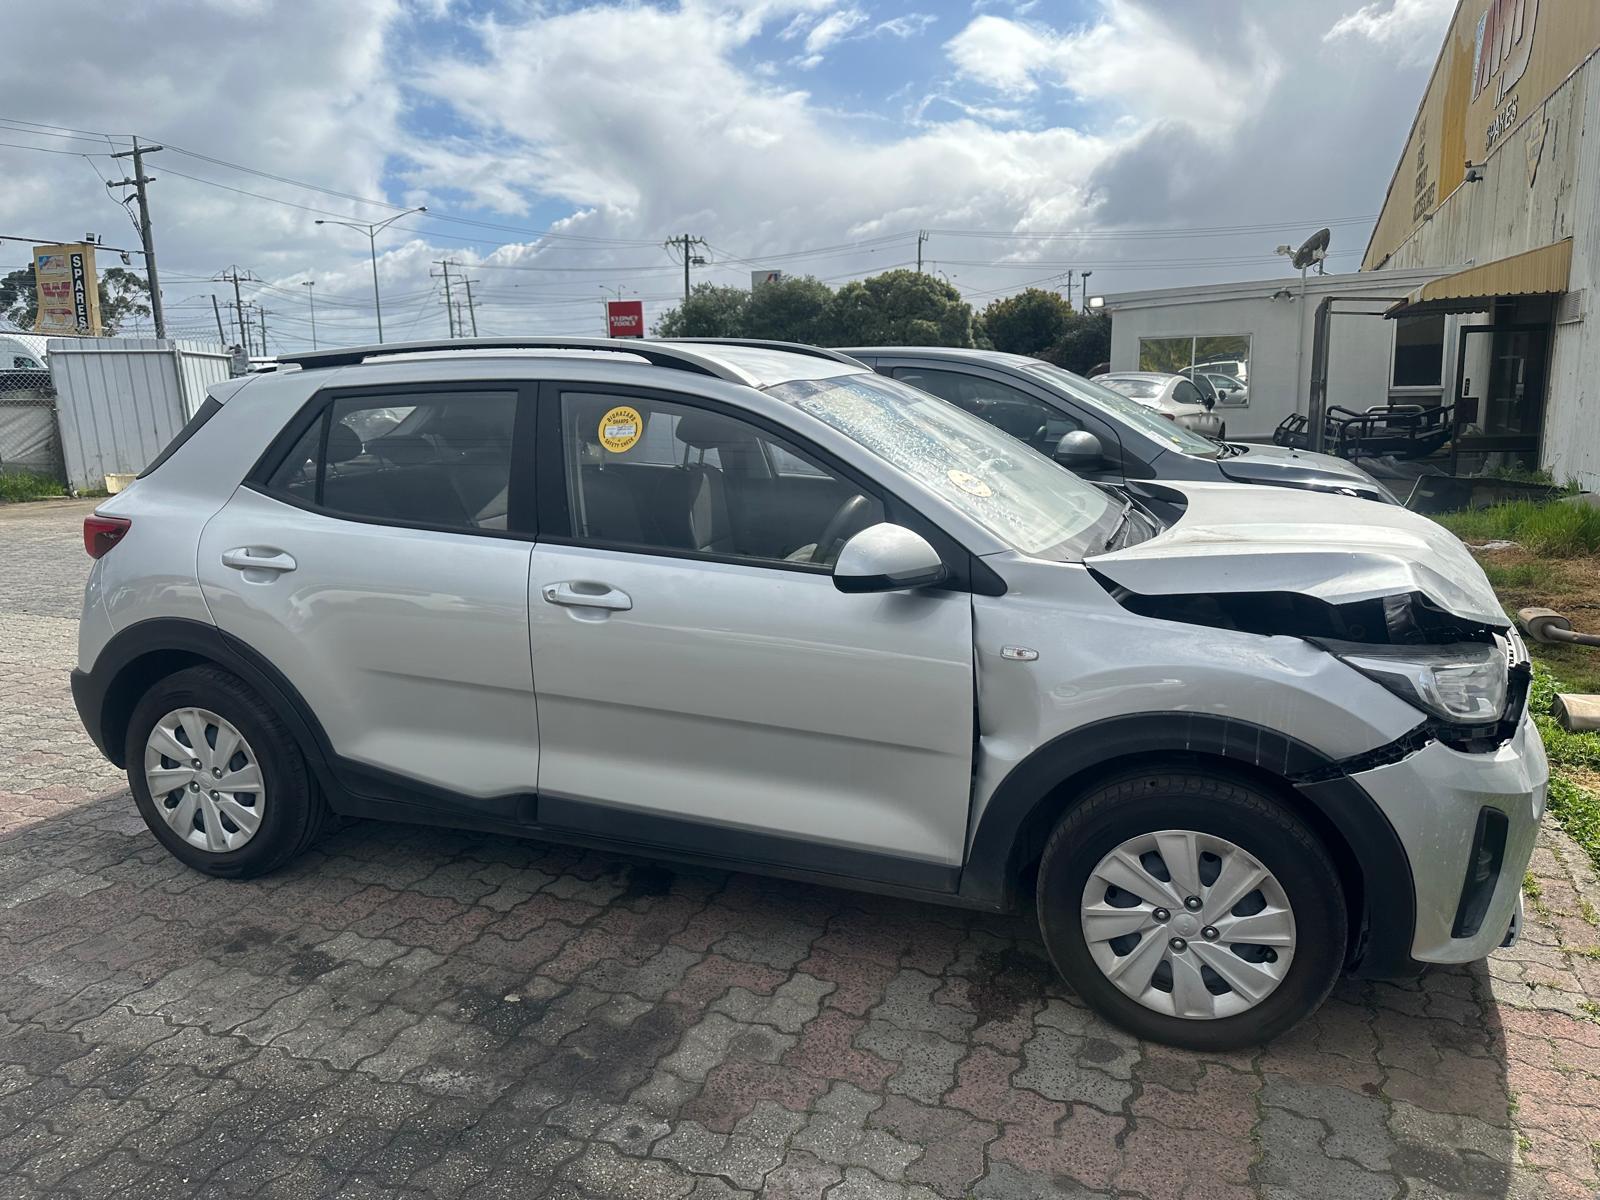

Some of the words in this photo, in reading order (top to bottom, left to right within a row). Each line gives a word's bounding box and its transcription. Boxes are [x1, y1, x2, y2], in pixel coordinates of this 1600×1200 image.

[72, 255, 87, 328] SPARES
[607, 411, 636, 422] BIOHAZARD
[604, 438, 620, 447] SAFETY
[620, 437, 634, 447] CHECK
